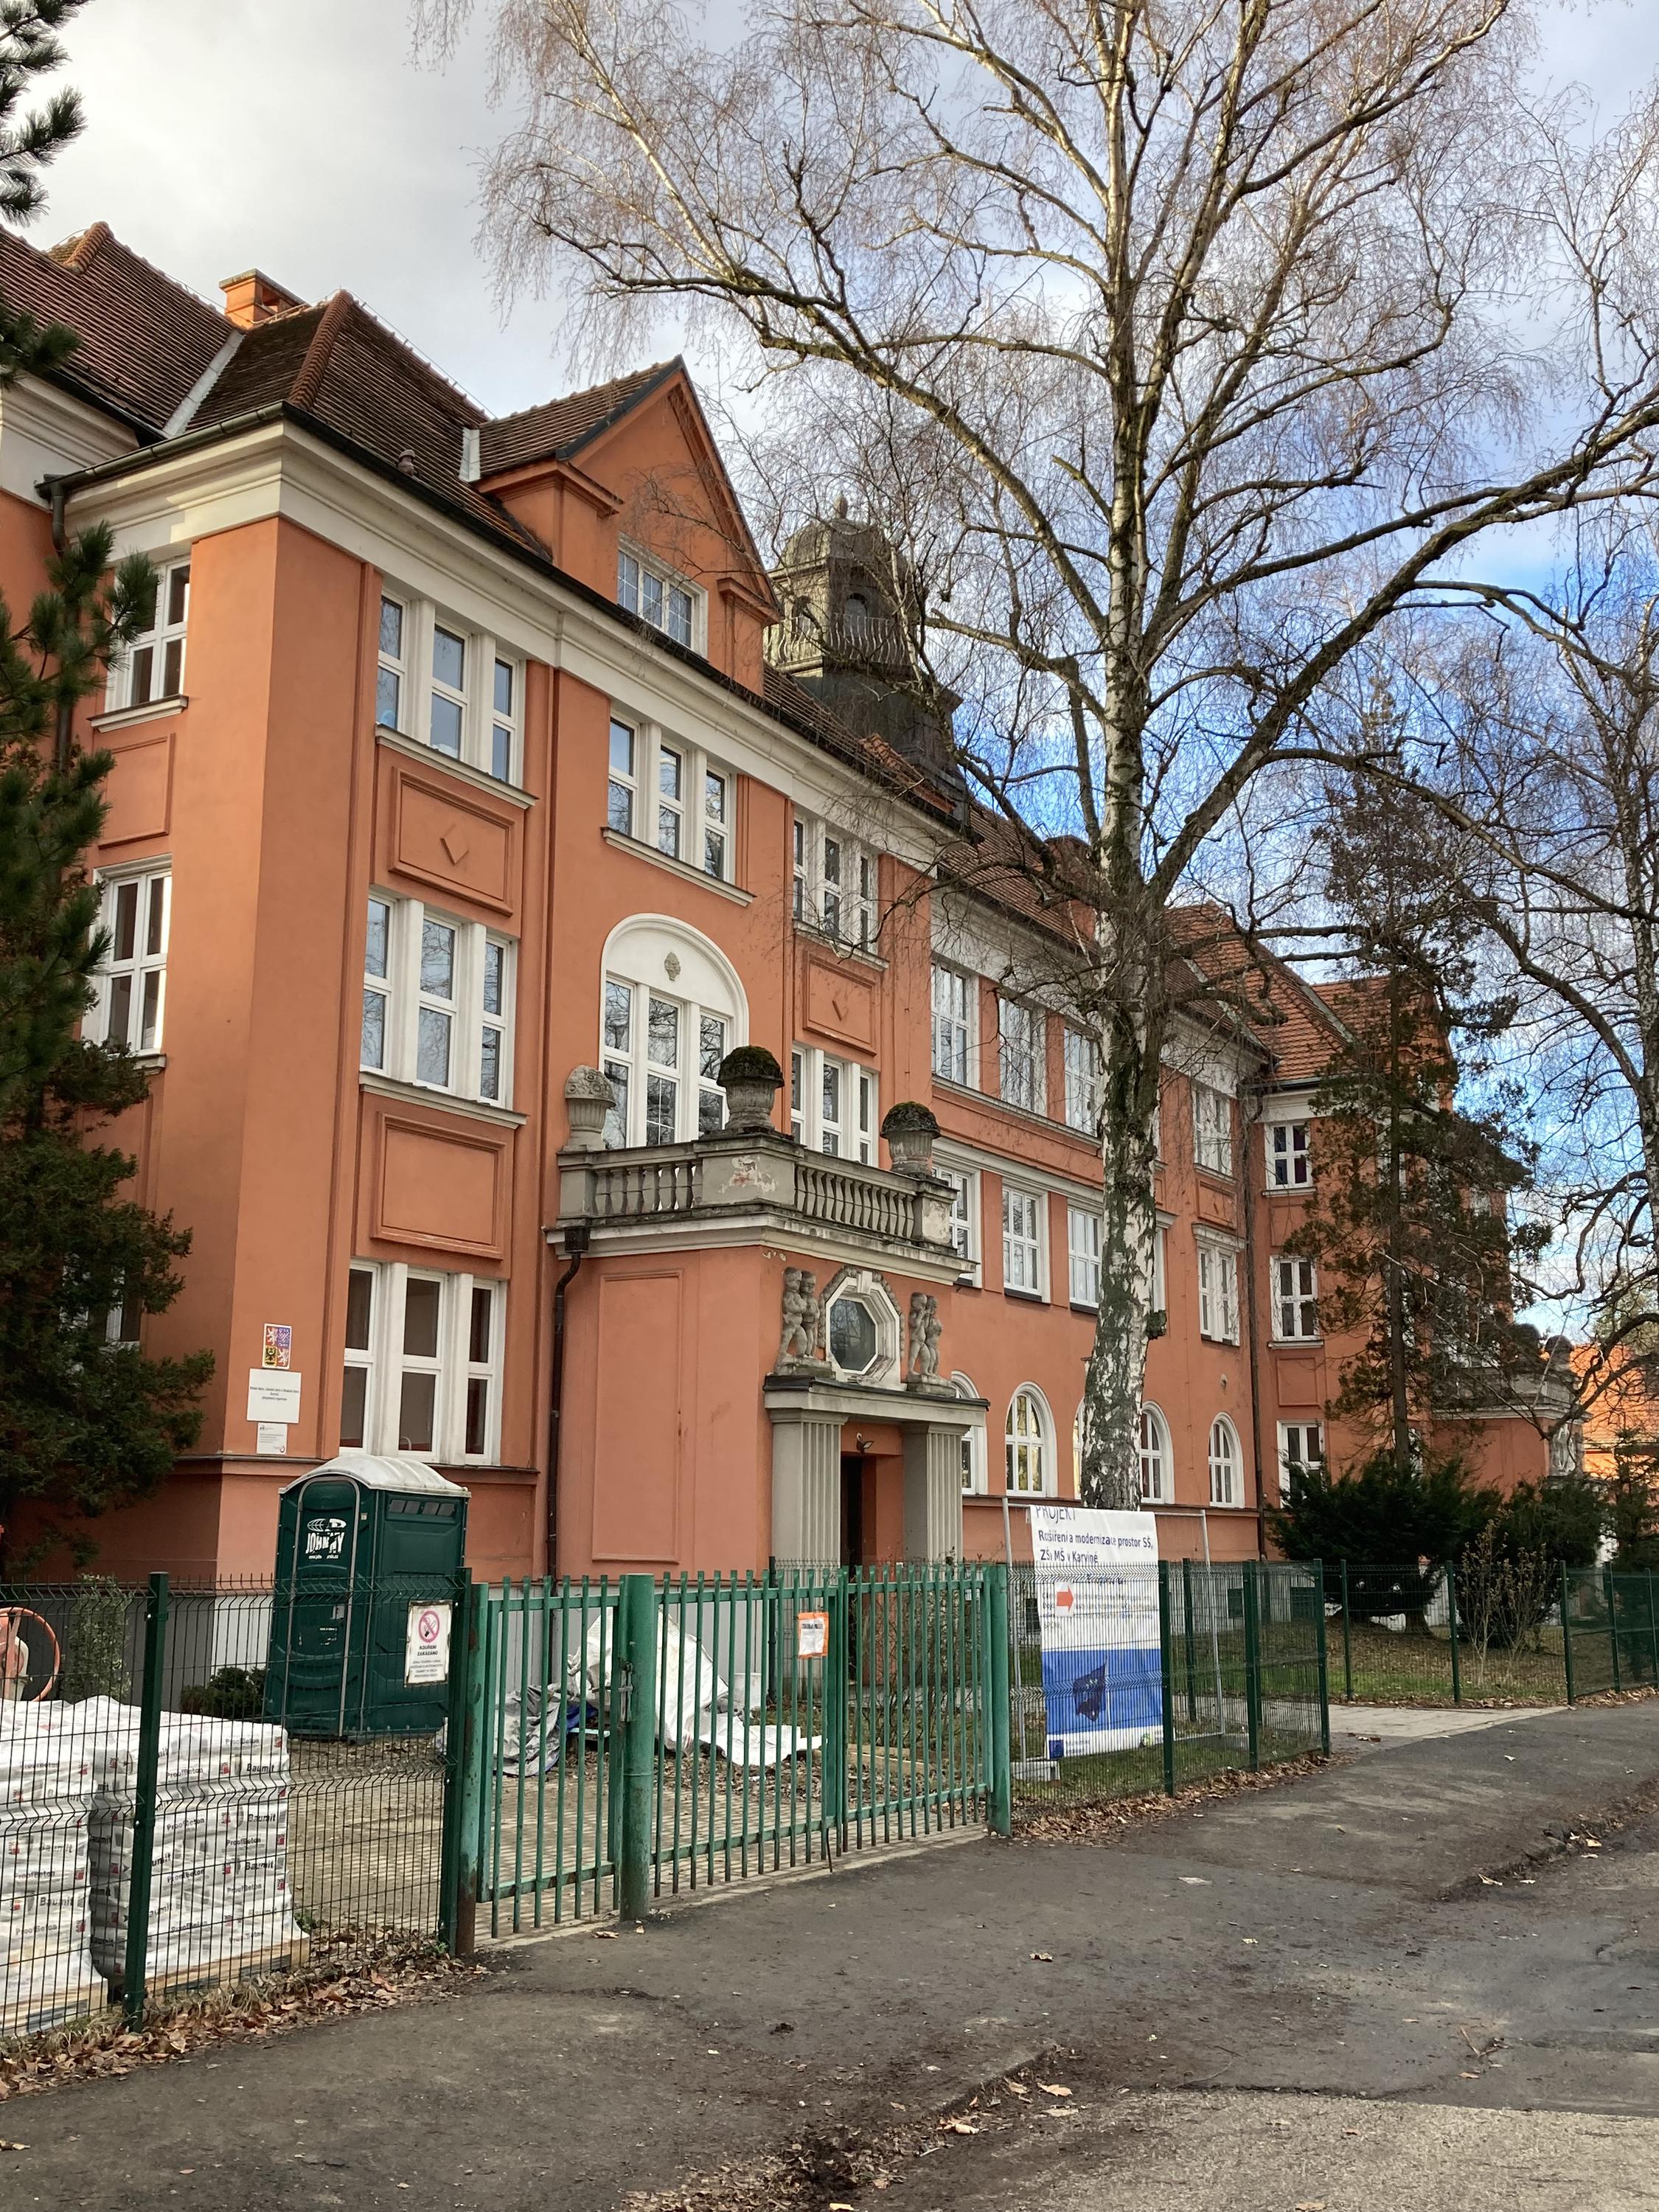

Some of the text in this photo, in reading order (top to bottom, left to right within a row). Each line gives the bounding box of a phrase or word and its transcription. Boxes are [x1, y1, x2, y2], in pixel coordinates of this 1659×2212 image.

[1069, 1534, 1074, 1543] a
[1118, 1537, 1141, 1550] prostor
[1143, 1535, 1153, 1549] SŠ,
[1054, 1548, 1065, 1562] MŠ
[152, 1852, 171, 1866] umit
